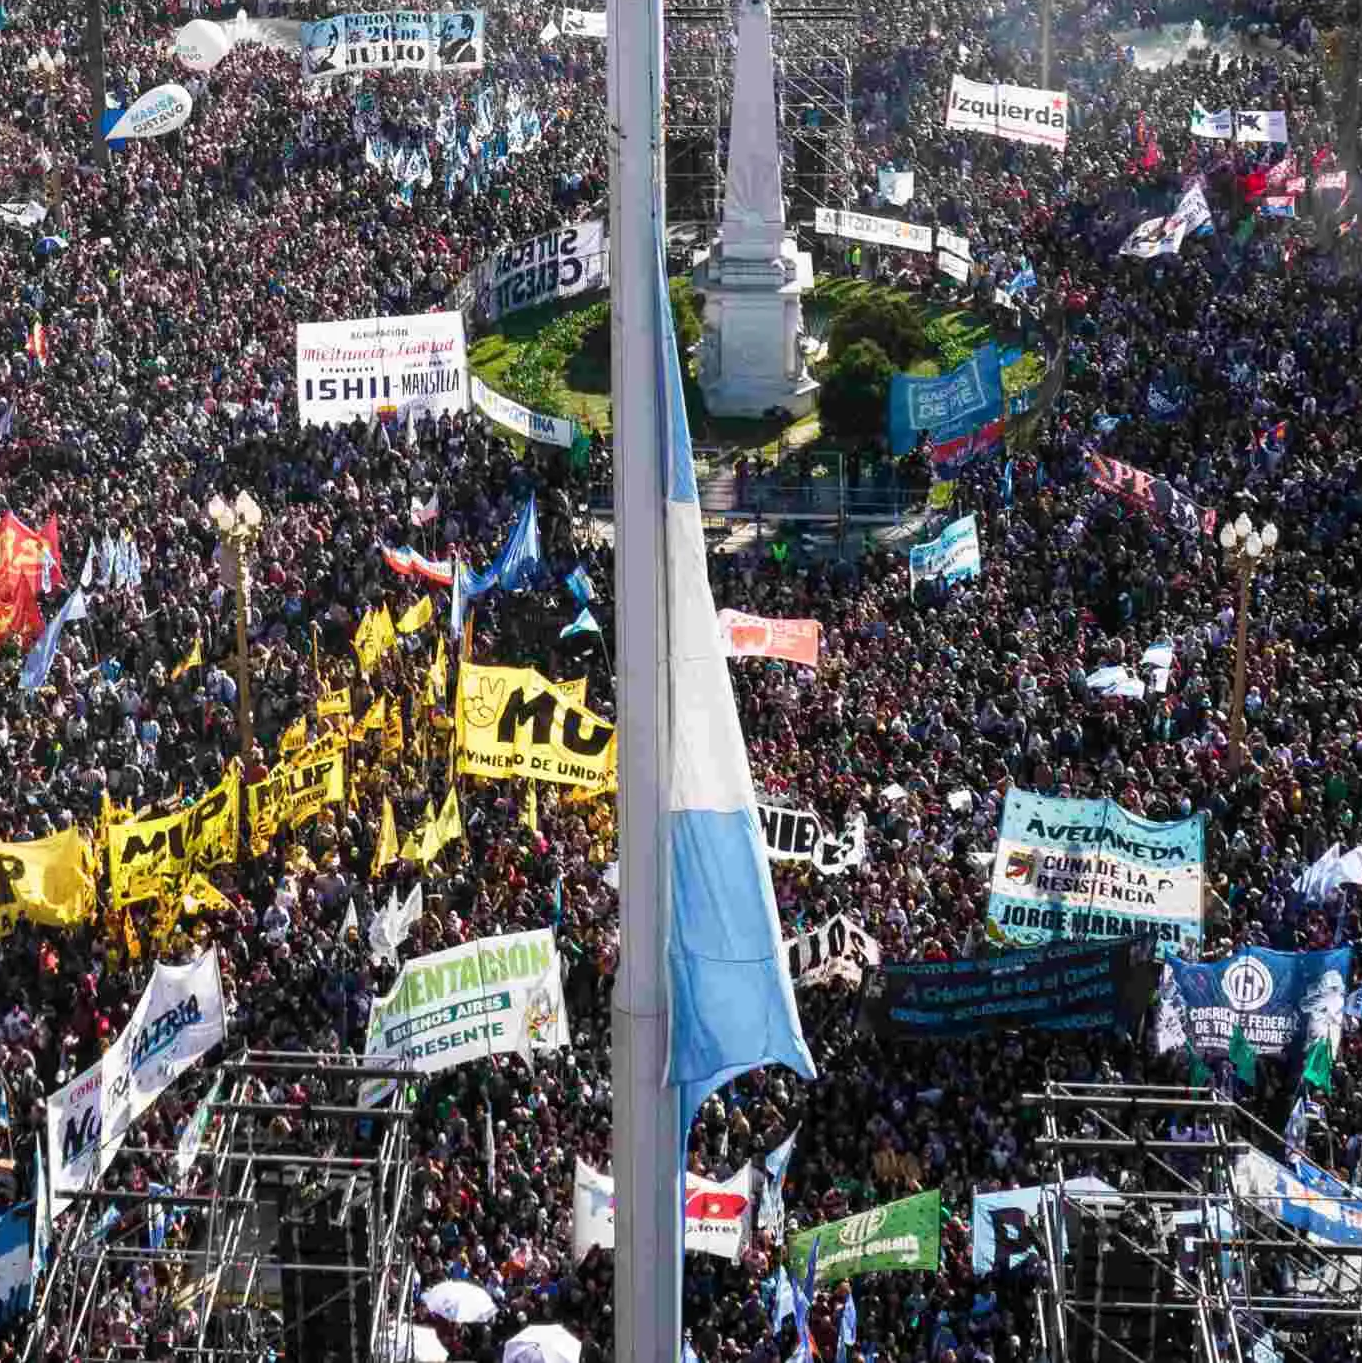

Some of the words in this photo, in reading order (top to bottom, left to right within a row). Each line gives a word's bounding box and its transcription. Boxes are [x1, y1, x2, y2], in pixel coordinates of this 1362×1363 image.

[344, 44, 425, 64] JULIO
[950, 91, 1064, 128] Izquierda
[497, 686, 614, 756] MU
[531, 757, 551, 771] DE
[1043, 855, 1093, 874] CUNA
[1098, 859, 1120, 879] DE
[1127, 870, 1147, 886] LA
[1038, 875, 1155, 904] RESISTENCIA
[1000, 905, 1067, 931] JORGE
[456, 995, 503, 1019] AIRES
[1195, 1021, 1210, 1034] DE
